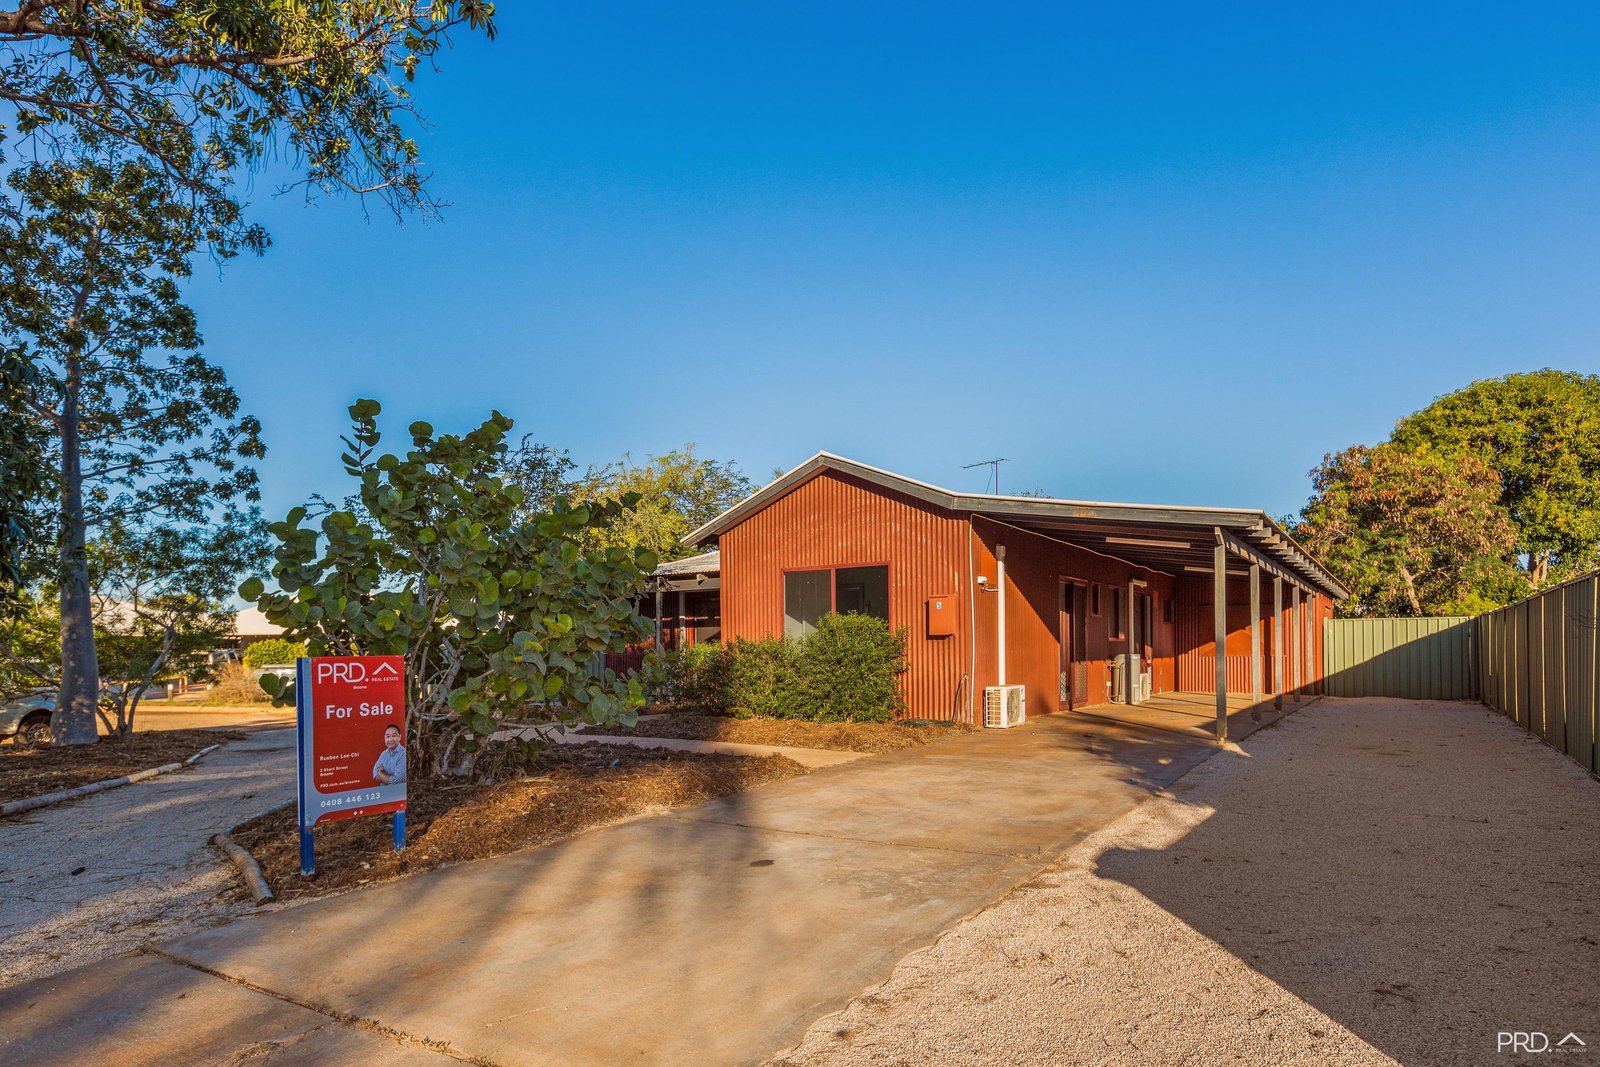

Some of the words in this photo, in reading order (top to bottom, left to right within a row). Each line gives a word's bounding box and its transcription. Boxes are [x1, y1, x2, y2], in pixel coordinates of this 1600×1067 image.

[326, 704, 353, 719] For
[360, 701, 393, 716] Sale
[320, 798, 342, 808] 0408
[345, 795, 362, 804] 446
[366, 792, 381, 800] 123
